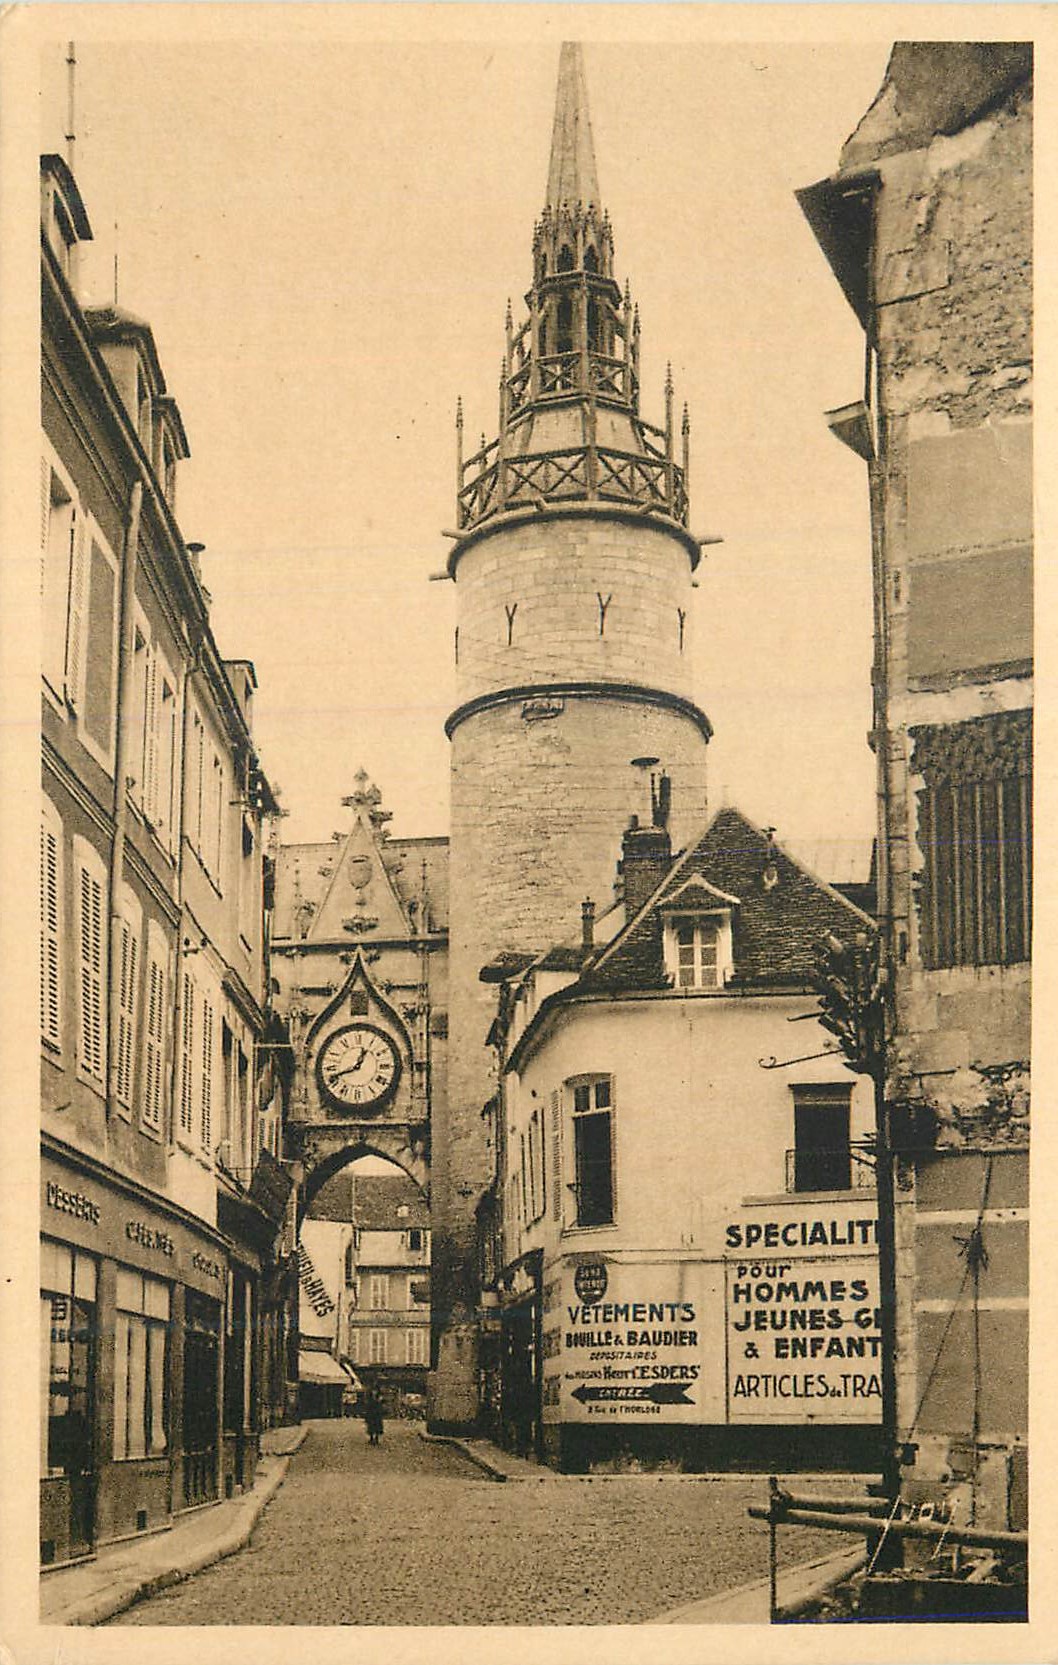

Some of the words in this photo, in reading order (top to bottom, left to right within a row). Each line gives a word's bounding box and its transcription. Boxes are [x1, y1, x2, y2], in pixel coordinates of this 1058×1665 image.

[733, 1280, 869, 1304] HOMMES
[734, 1308, 844, 1332] JEUNES
[614, 1334, 625, 1346] &
[627, 1330, 698, 1347] BAUDIER
[744, 1341, 760, 1359] &
[733, 1374, 829, 1398] ARTICLES
